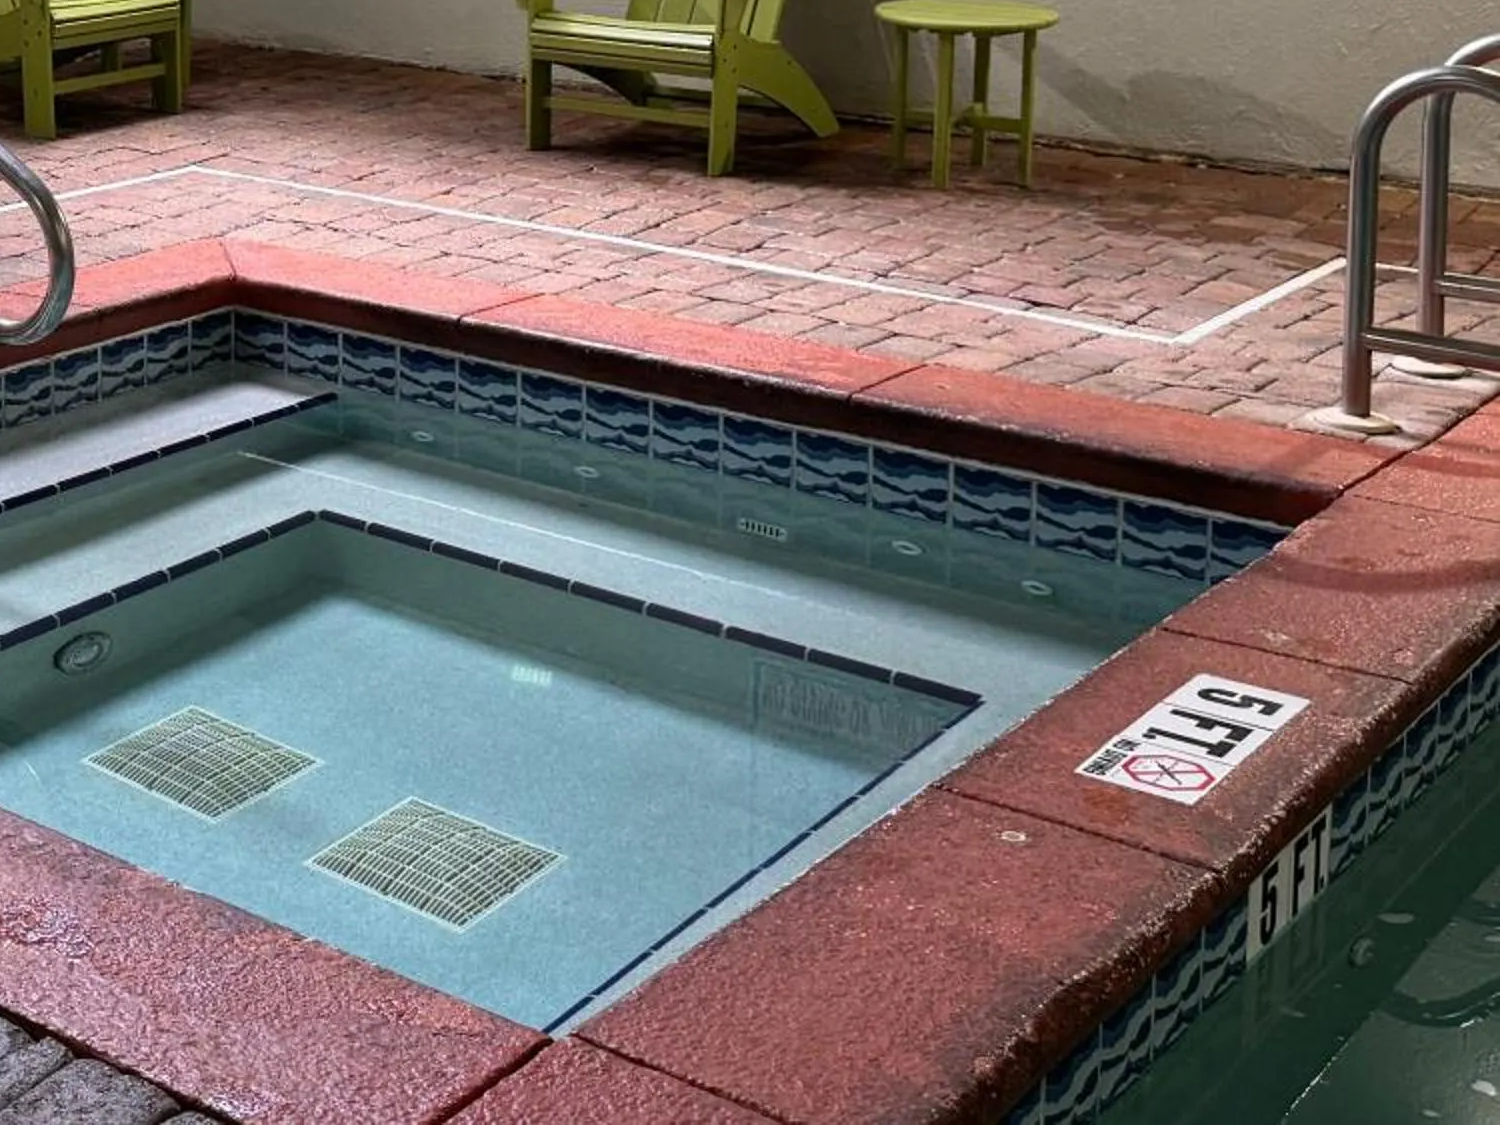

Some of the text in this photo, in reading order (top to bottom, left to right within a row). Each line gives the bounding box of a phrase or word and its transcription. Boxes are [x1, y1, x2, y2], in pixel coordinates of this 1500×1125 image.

[1142, 688, 1284, 758] 5 FT.
[1259, 814, 1327, 946] 5 FT.
